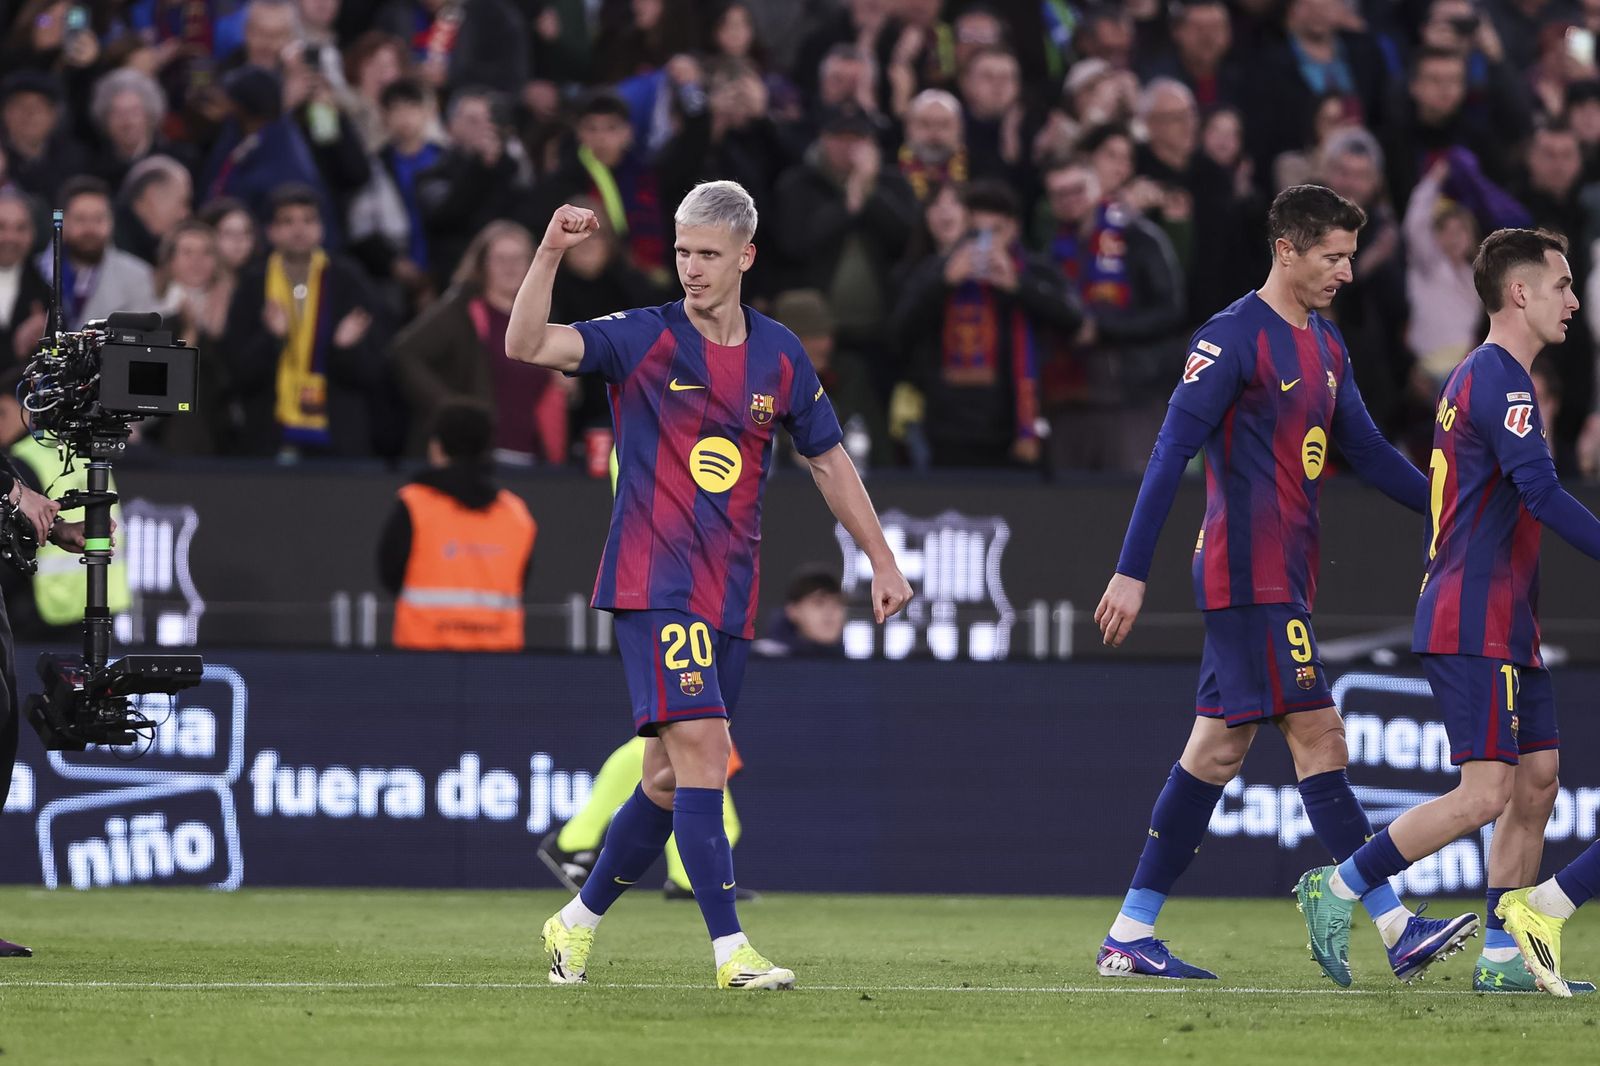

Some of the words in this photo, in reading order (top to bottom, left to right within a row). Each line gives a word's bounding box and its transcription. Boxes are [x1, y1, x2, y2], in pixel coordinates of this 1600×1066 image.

[660, 621, 713, 670] 20
[1286, 618, 1312, 663] 9
[250, 748, 426, 819] fuera
[436, 751, 520, 821] de
[1208, 775, 1315, 849] Cap
[68, 809, 215, 891] niño
[1388, 838, 1483, 896] en
